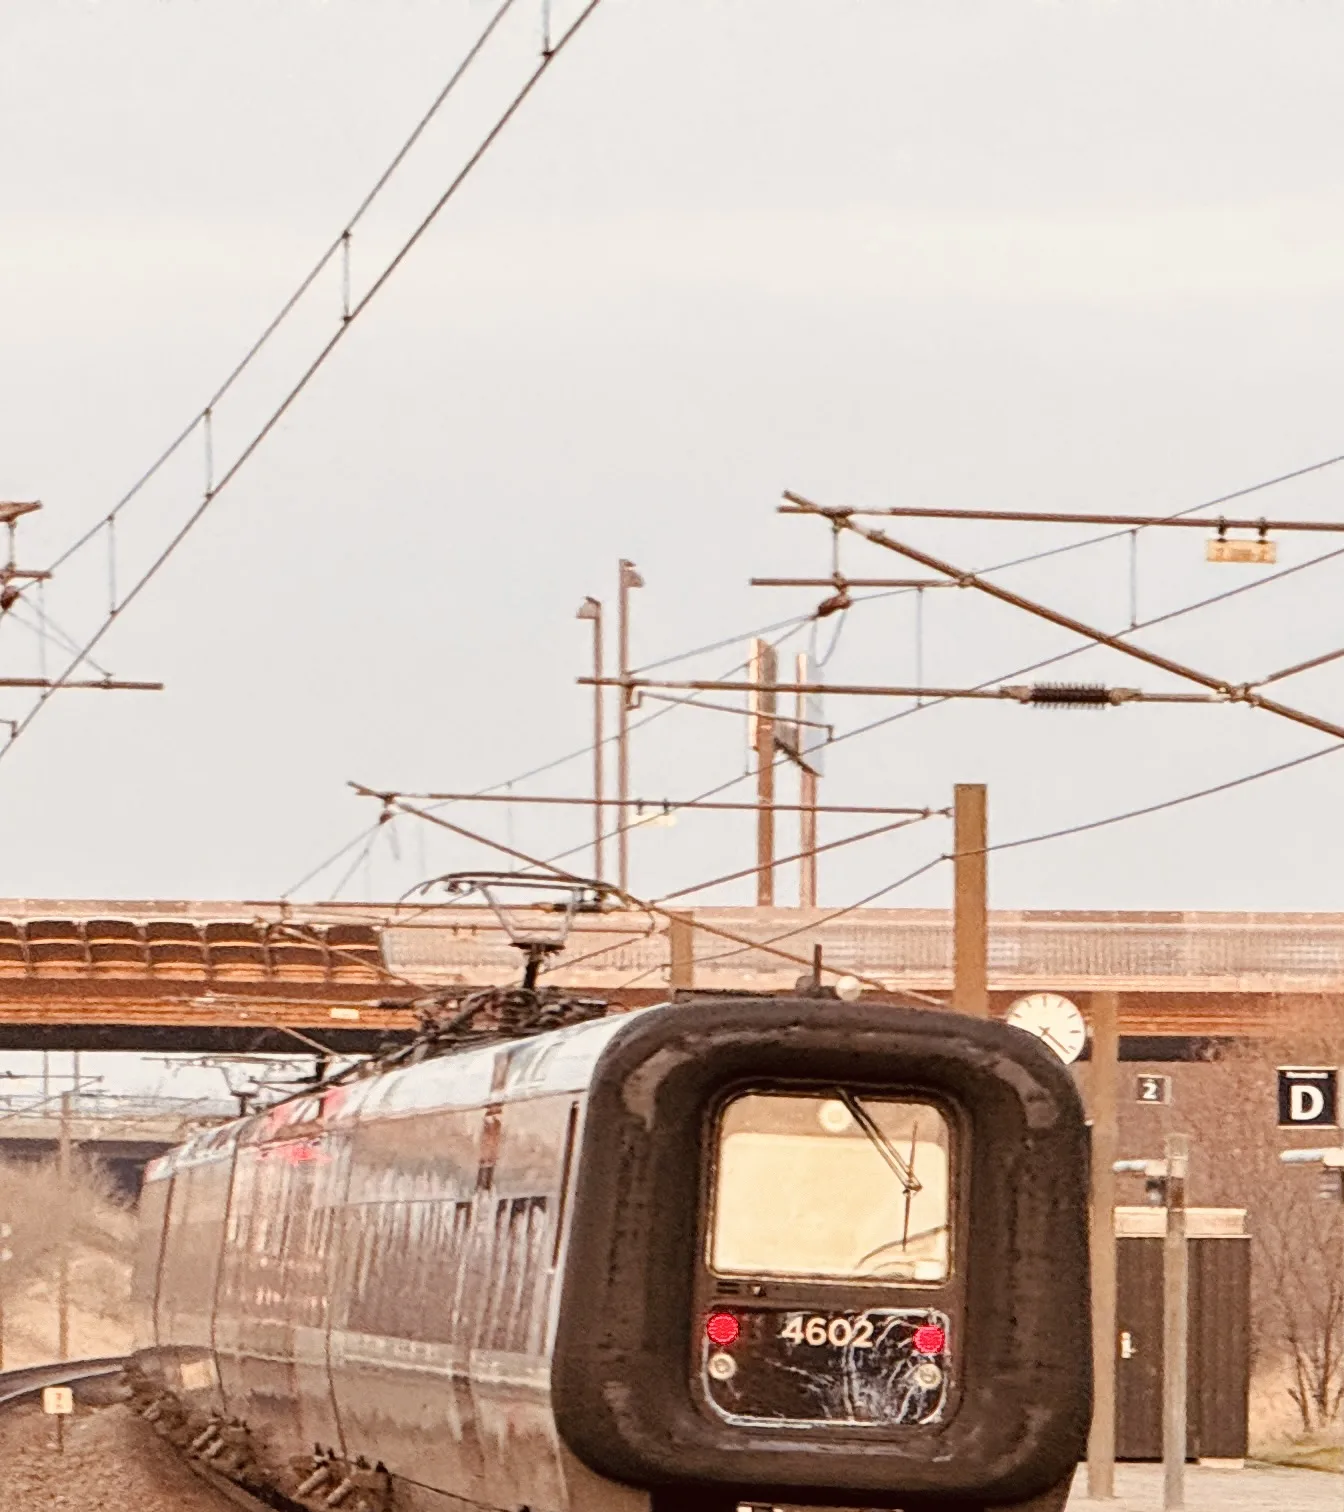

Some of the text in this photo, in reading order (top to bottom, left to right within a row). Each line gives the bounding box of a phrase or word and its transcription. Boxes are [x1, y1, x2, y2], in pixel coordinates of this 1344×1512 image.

[1141, 1081, 1159, 1100] 2
[1289, 1084, 1325, 1121] D
[780, 1316, 875, 1349] 4602
